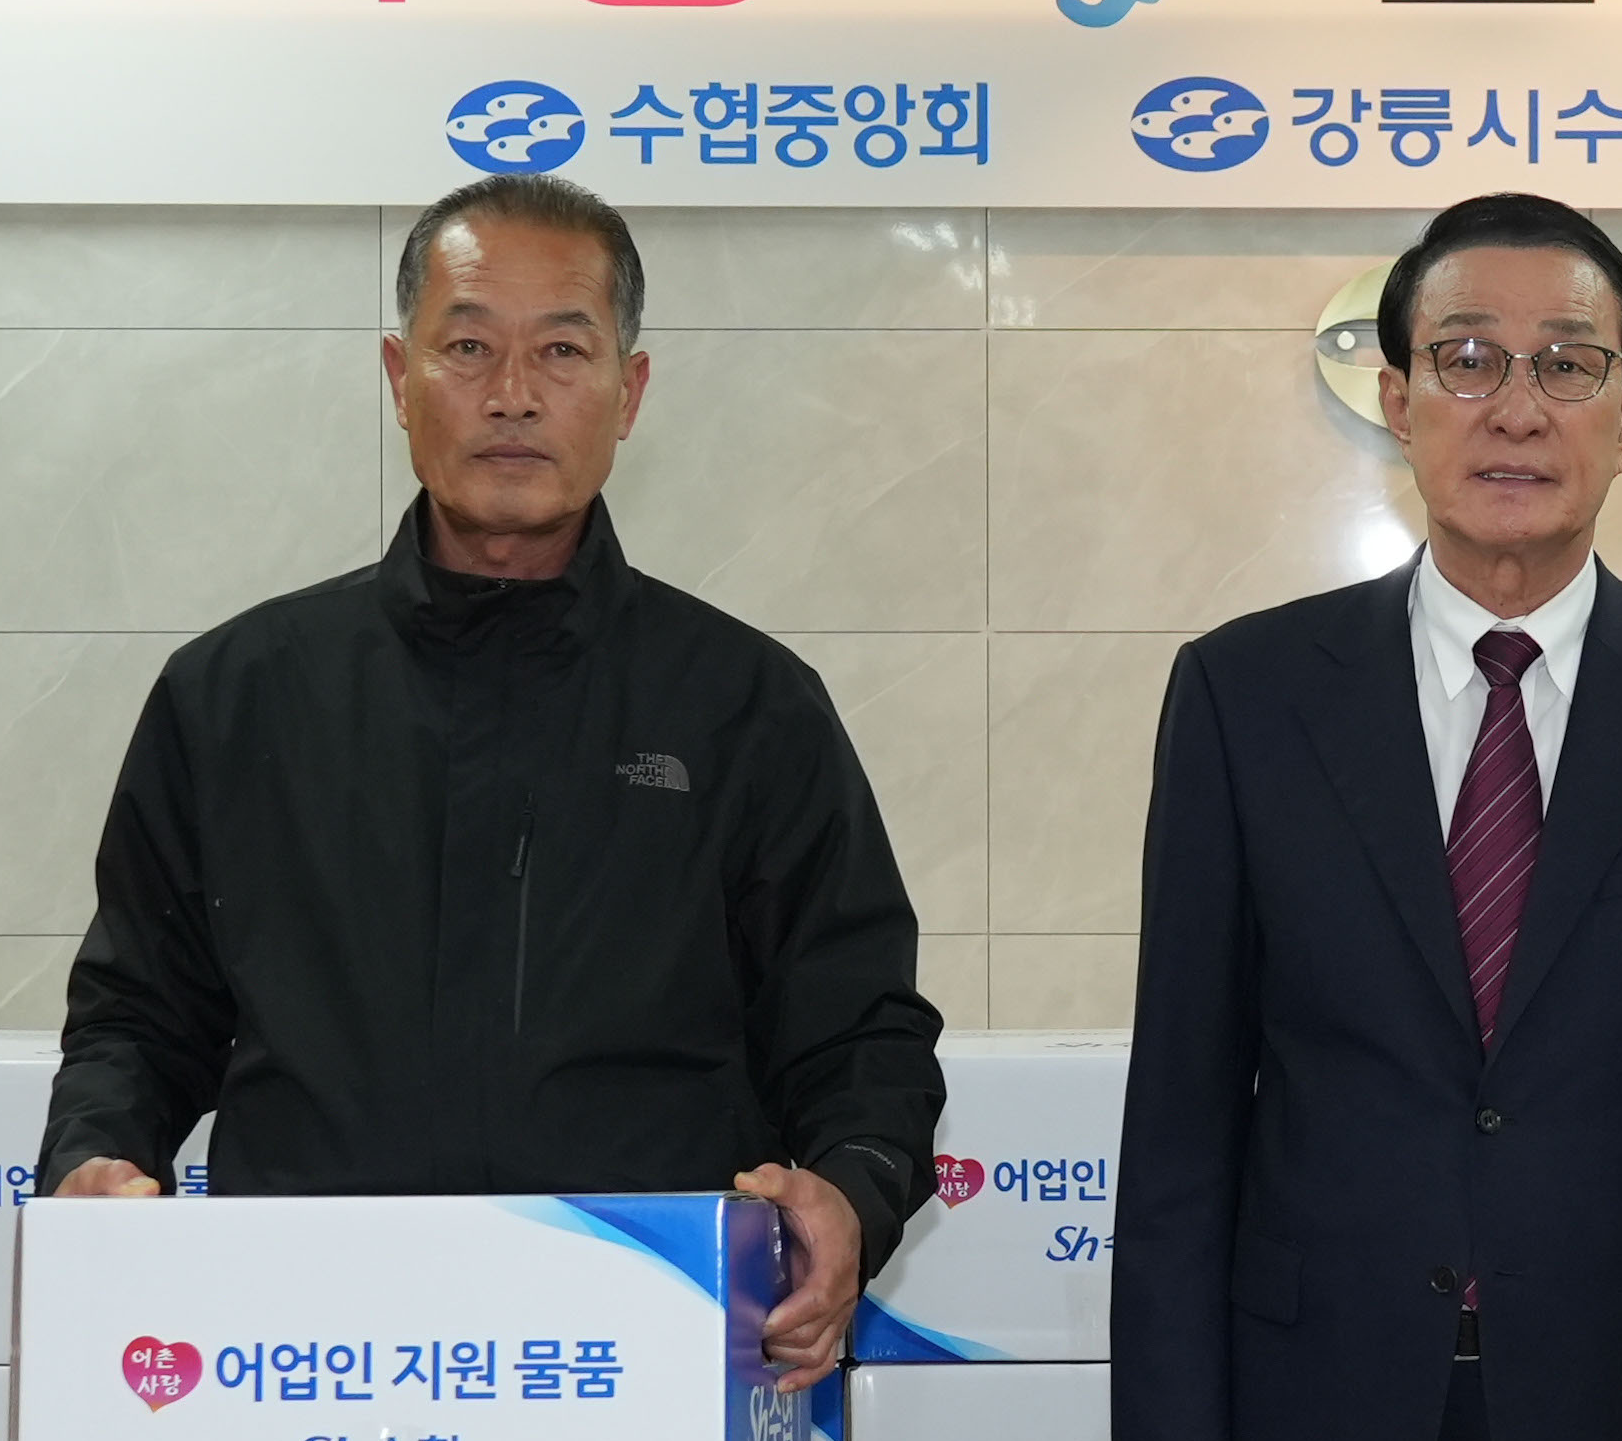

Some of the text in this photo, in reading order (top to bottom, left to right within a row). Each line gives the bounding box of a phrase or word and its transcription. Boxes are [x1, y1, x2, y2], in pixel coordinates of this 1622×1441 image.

[609, 82, 991, 169] 수협중앙회
[616, 764, 665, 776] NORTH
[636, 753, 665, 765] THE
[629, 775, 664, 788] FACE
[994, 1158, 1107, 1202] 어업인
[1046, 1224, 1114, 1262] Sh
[130, 1347, 177, 1370] 어촌
[215, 1339, 625, 1403] 어업인 지원 물품
[137, 1373, 183, 1396] 사랑
